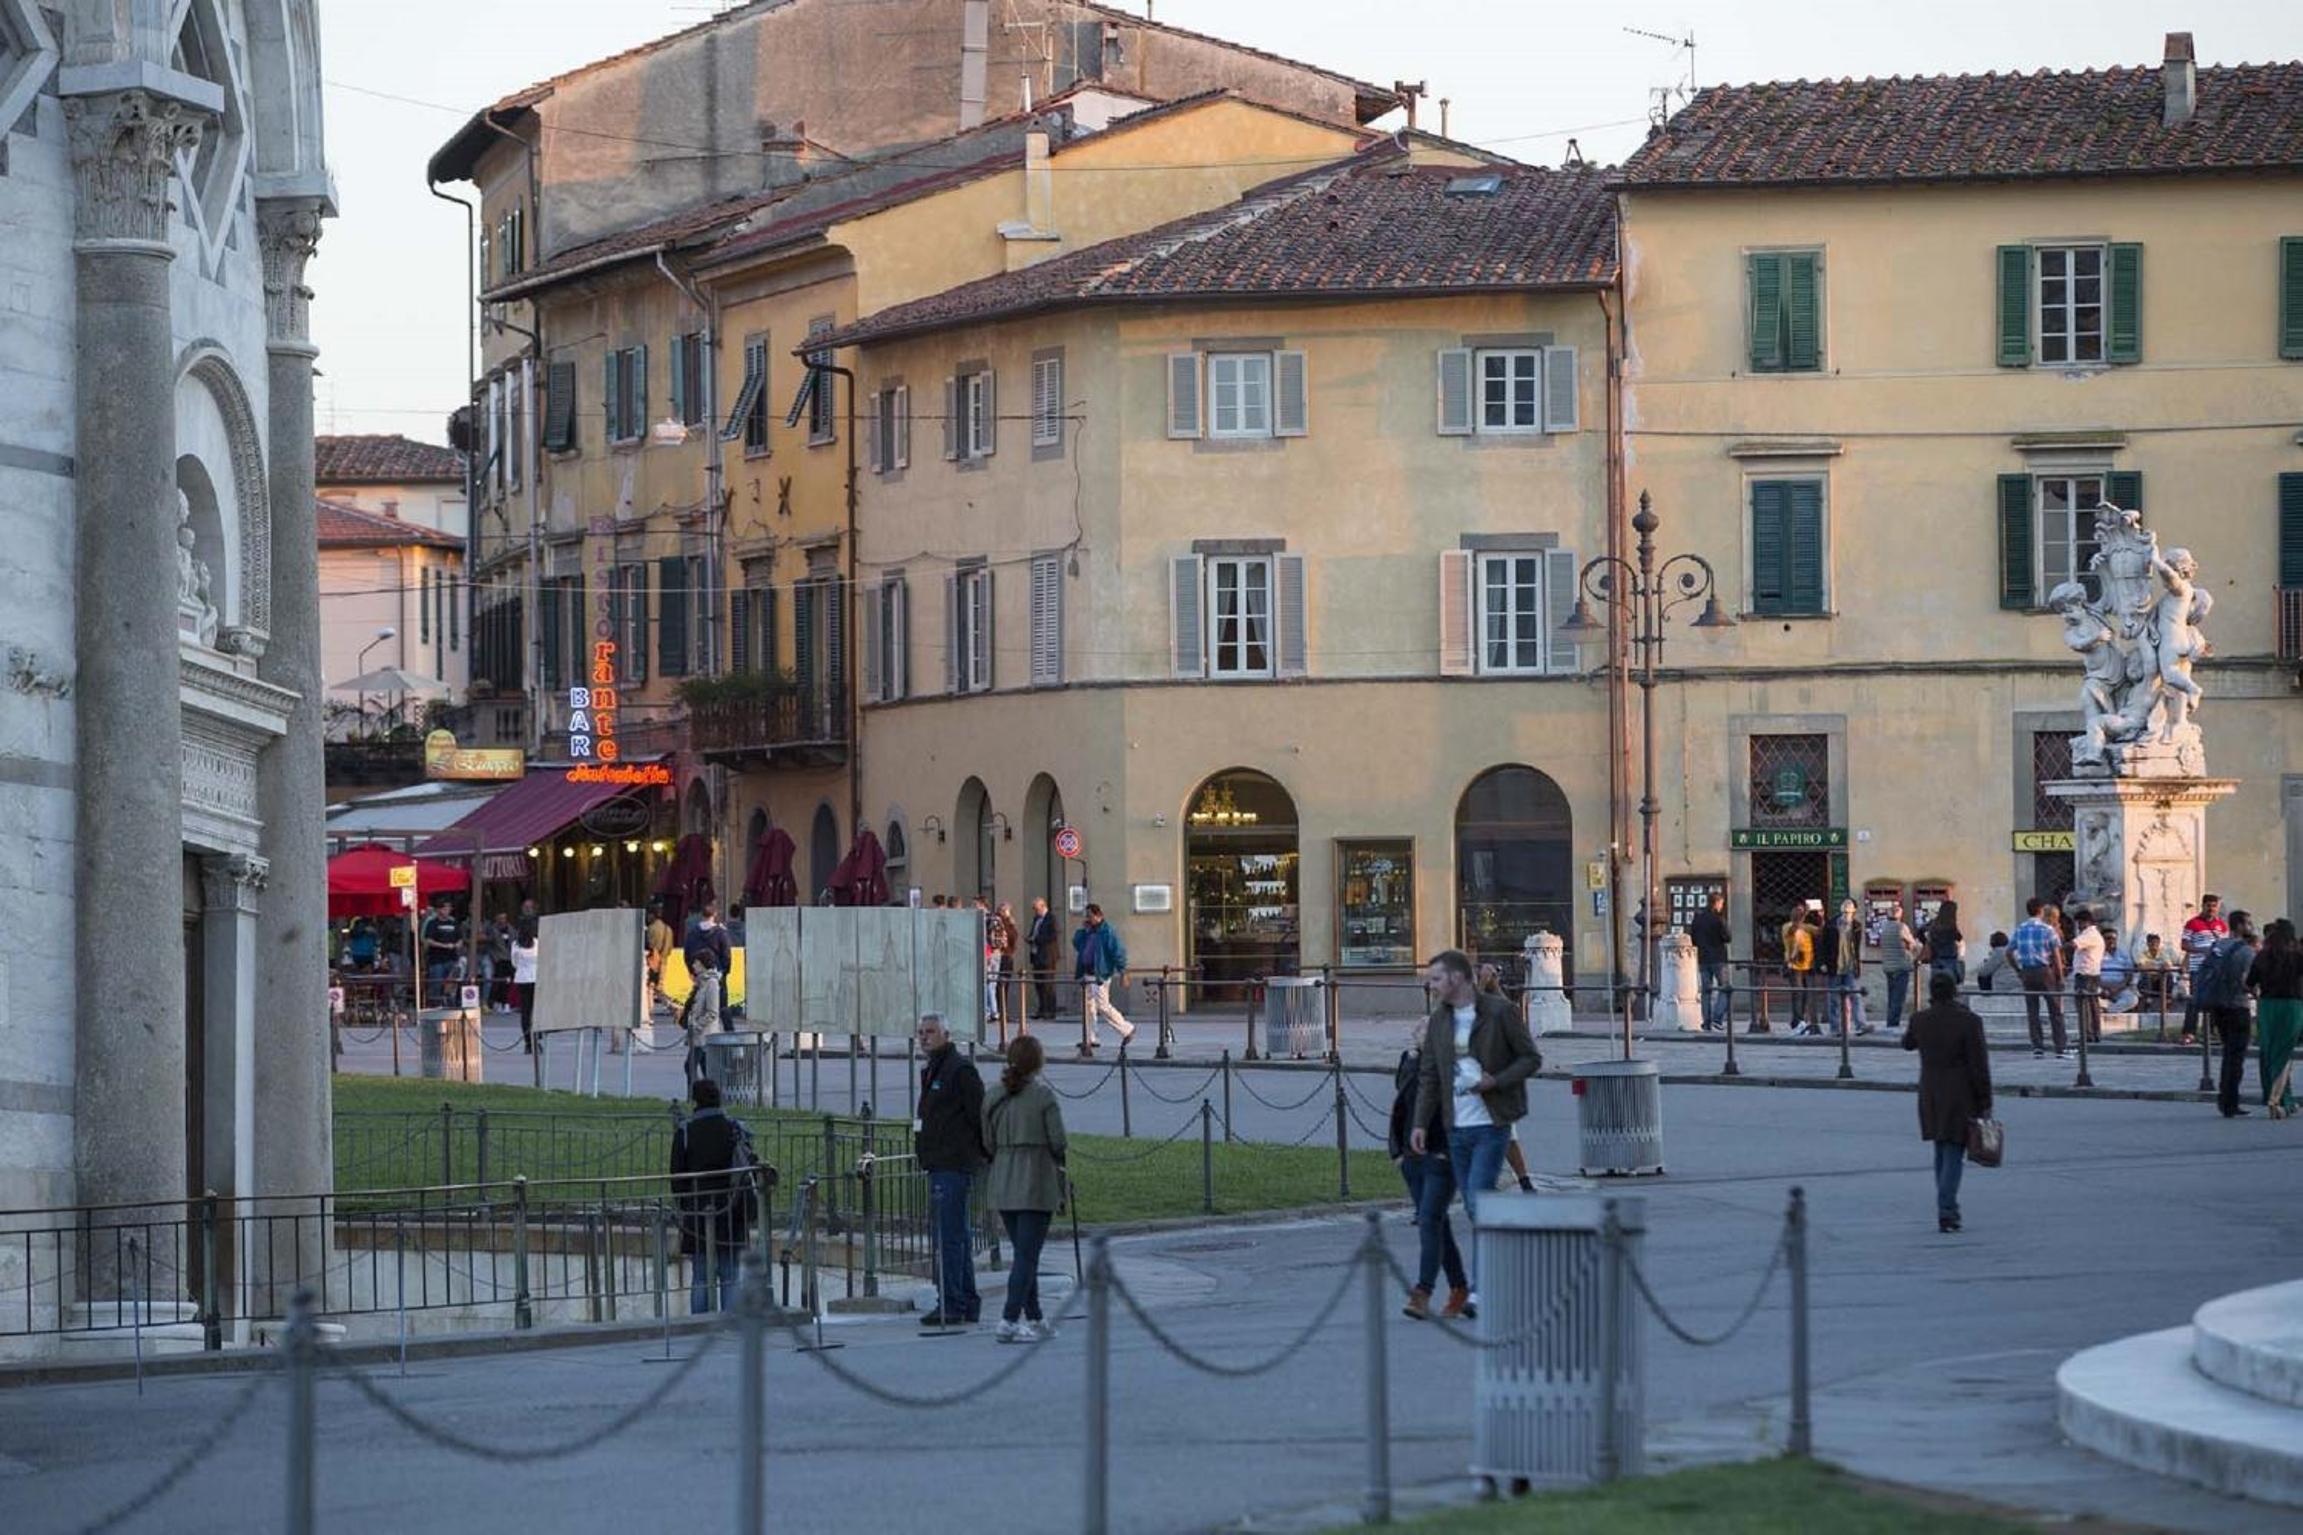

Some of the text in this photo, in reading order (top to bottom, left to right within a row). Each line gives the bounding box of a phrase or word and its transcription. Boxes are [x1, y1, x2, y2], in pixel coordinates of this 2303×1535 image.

[569, 687, 590, 757] BAR
[1757, 833, 1822, 845] IL PAPIRO
